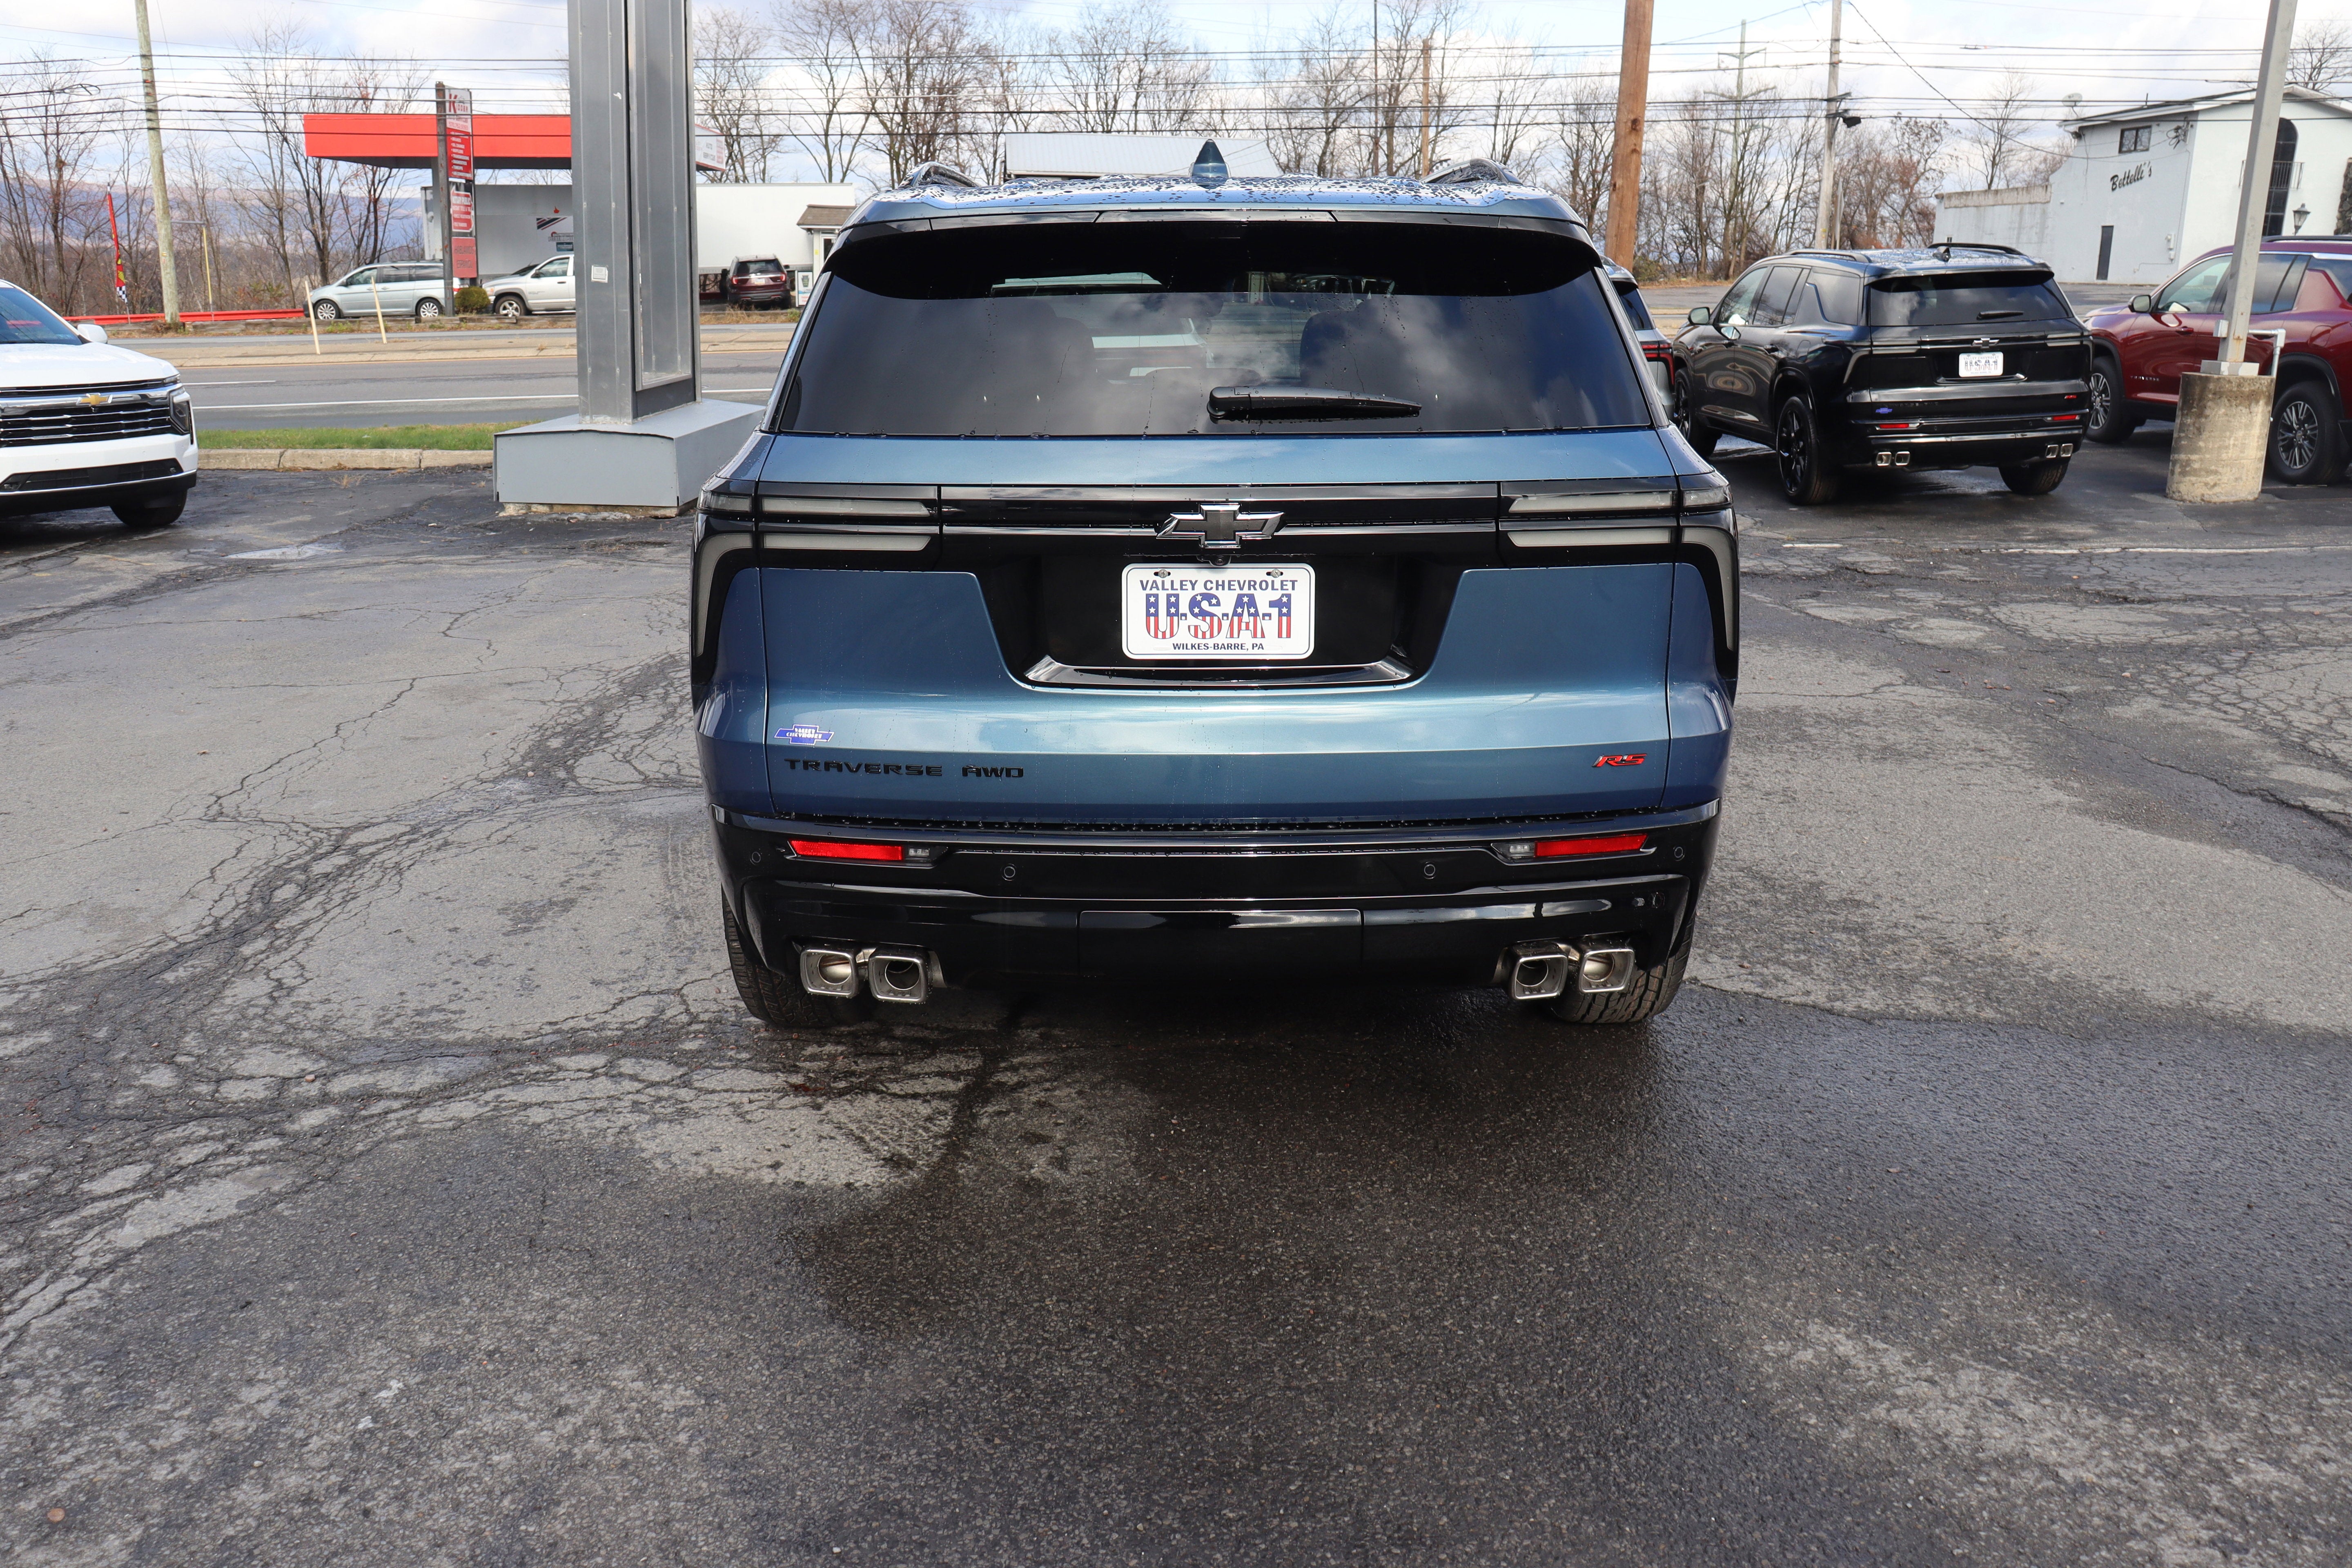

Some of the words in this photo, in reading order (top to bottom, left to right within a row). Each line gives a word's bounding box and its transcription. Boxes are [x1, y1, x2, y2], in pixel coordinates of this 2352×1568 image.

[1140, 580, 1198, 590] VALLEY
[1203, 580, 1298, 591] CHEVROLET
[1172, 643, 1249, 651] WILKES-BARRE,
[1592, 753, 1647, 767] RS
[784, 758, 942, 776] TRAVERSE
[962, 765, 1024, 777] AWD
